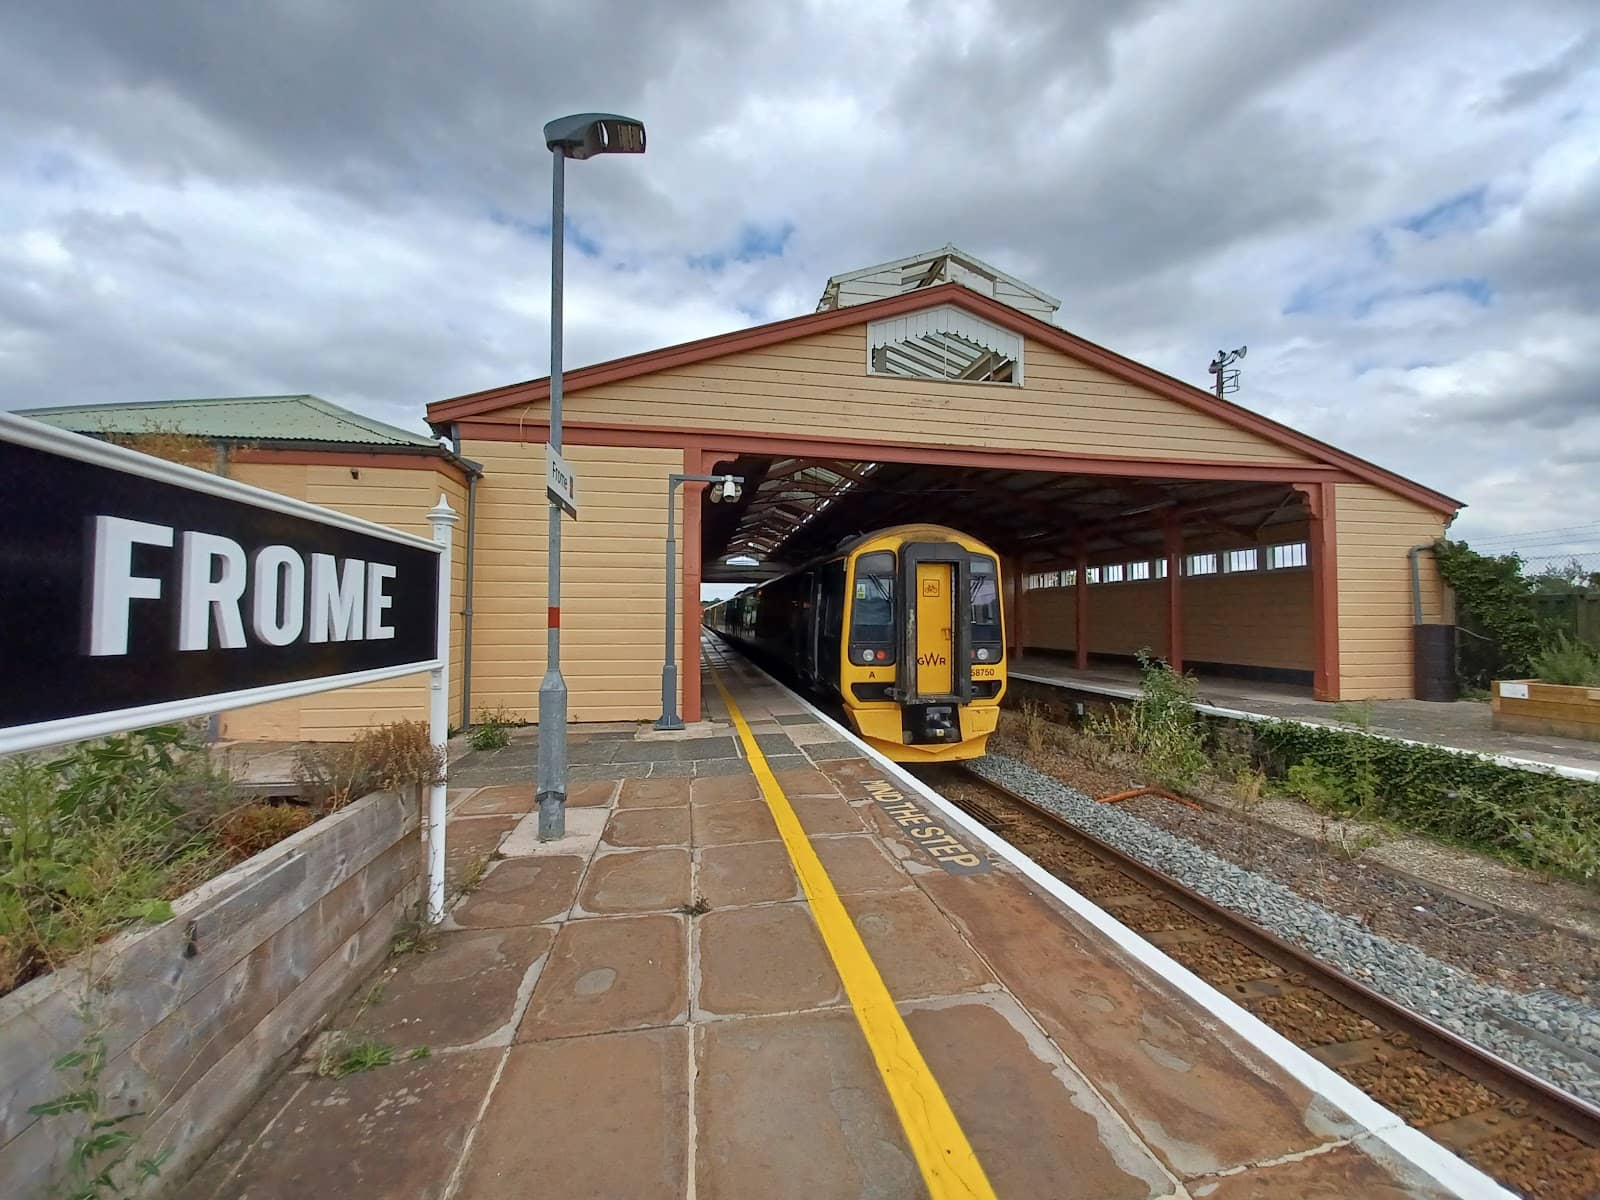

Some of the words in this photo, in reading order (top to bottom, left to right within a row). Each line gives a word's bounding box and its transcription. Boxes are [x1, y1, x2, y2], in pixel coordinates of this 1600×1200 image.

[552, 461, 568, 490] Frome
[89, 514, 397, 656] FROME
[917, 652, 946, 666] GWR
[869, 671, 876, 679] A
[859, 779, 904, 802] MIND
[884, 801, 933, 826] THE
[910, 826, 980, 867] STEP
